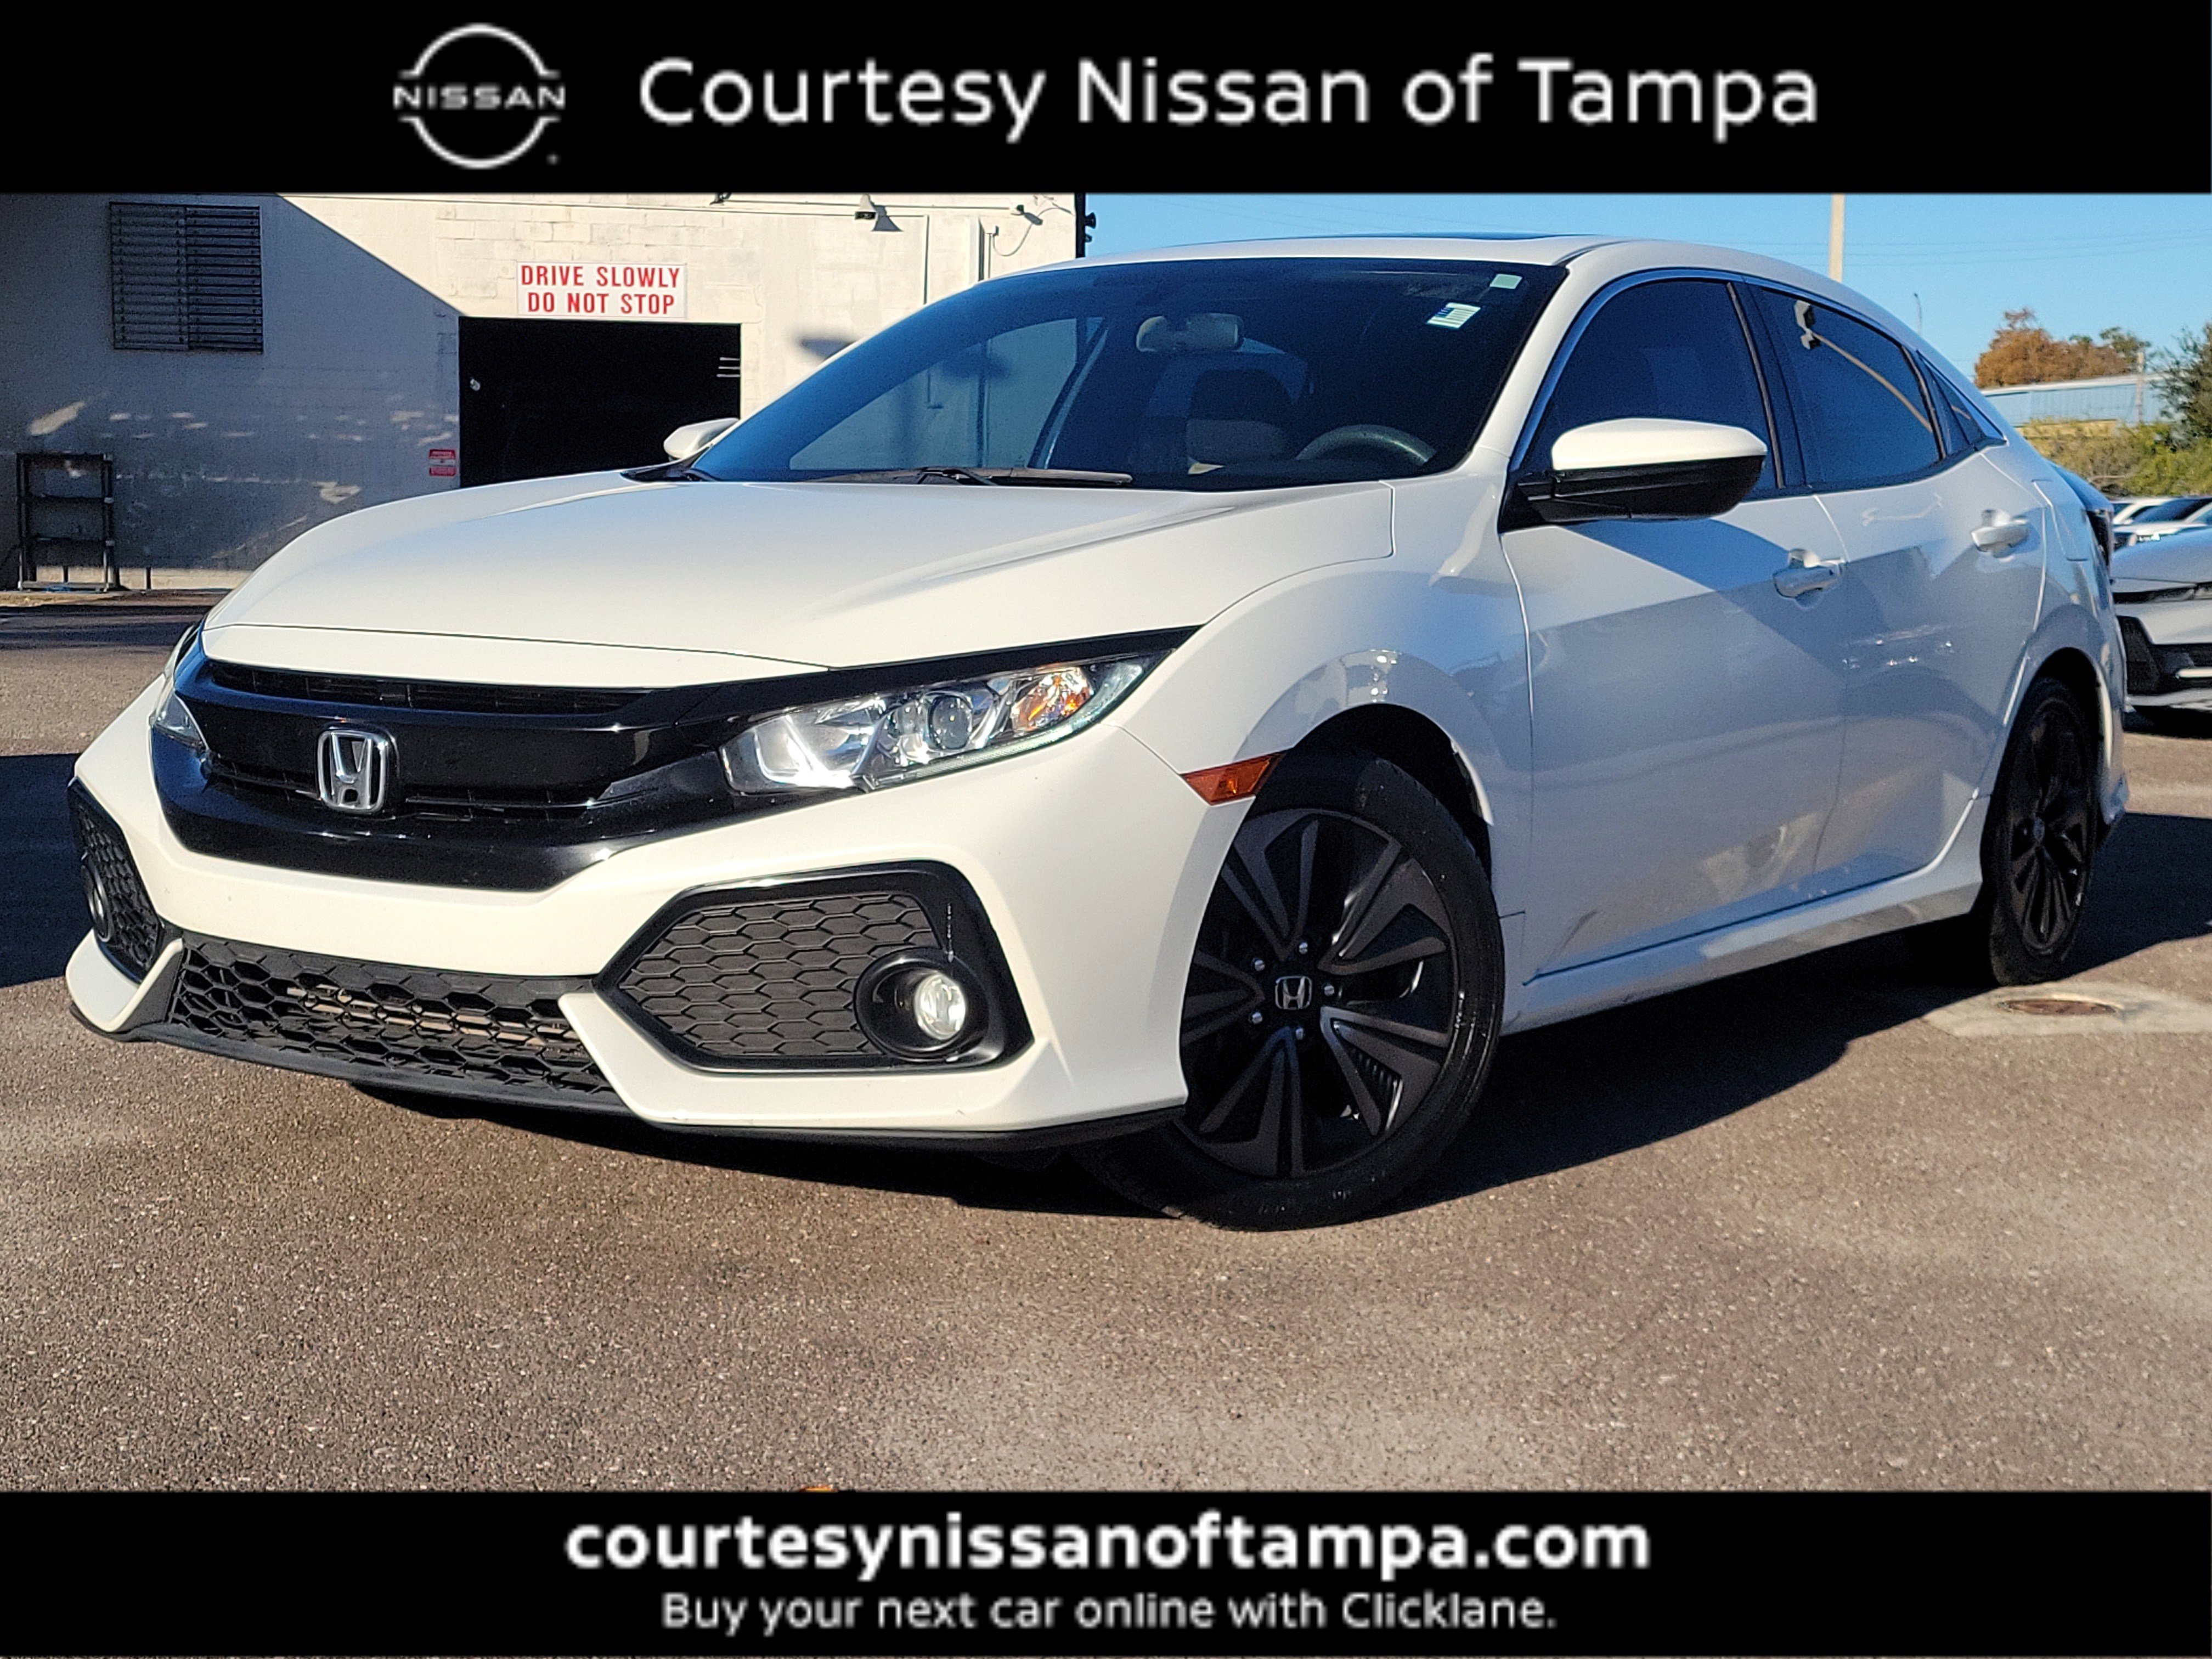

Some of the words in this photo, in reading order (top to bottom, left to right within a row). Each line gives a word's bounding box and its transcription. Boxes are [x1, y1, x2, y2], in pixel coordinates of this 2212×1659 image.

[521, 265, 584, 286] DRIVE
[596, 266, 680, 288] SLOWLY
[528, 292, 555, 313] DO
[567, 292, 609, 313] NOT
[620, 293, 675, 314] STOP
